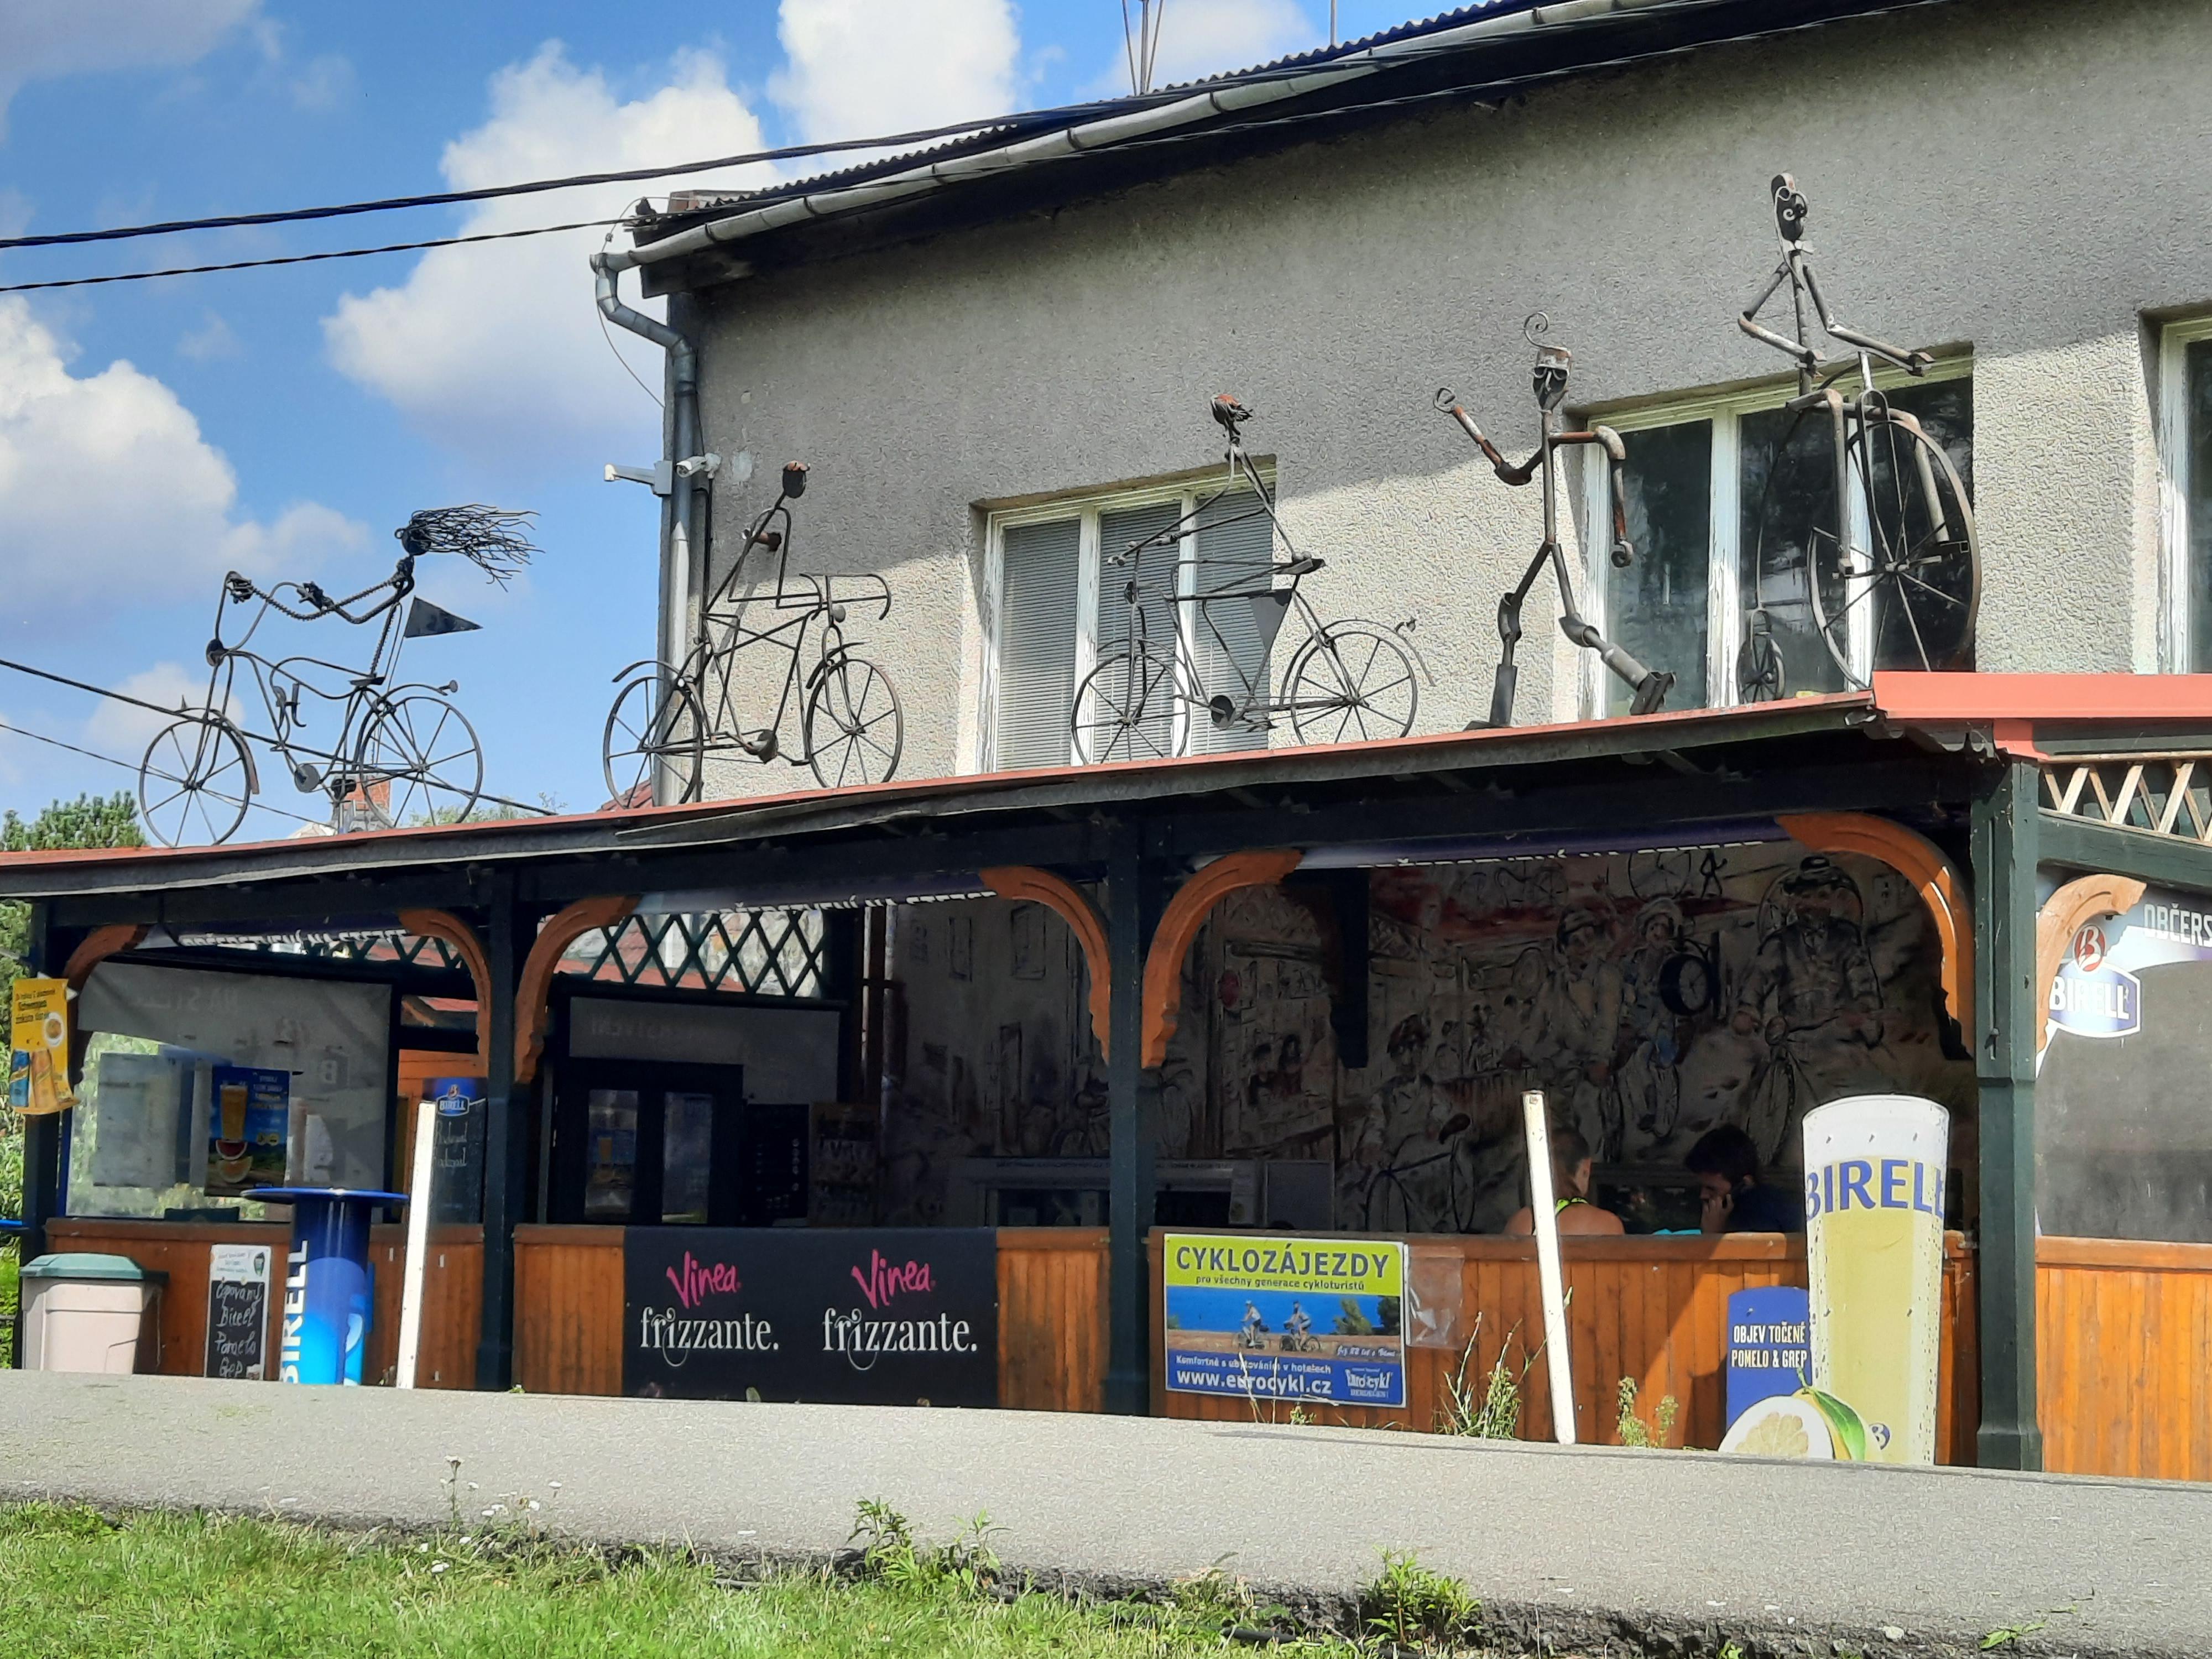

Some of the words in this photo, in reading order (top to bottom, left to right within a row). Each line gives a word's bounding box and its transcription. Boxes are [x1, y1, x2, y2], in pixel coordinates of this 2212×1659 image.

[2049, 975, 2129, 1020] BIRELL
[1176, 1243, 1389, 1278] CYKLOZÁJEZDY
[666, 1250, 738, 1309] Vinea
[851, 1248, 931, 1310] Vinea
[1214, 1275, 1253, 1287] všechny
[1255, 1279, 1300, 1288] generace
[1303, 1279, 1364, 1291] cykloturistů
[640, 1306, 779, 1367] frizzante.
[822, 1307, 978, 1370] frizzante.
[1733, 1324, 1766, 1344] OBJEV
[1768, 1321, 1806, 1344] TOČENÉ
[1291, 1363, 1331, 1374] hotelech
[1731, 1349, 1769, 1368] POMELO
[1772, 1350, 1780, 1368] &
[1782, 1349, 1807, 1368] GREP
[1176, 1370, 1332, 1396] www.eurocykl.cz
